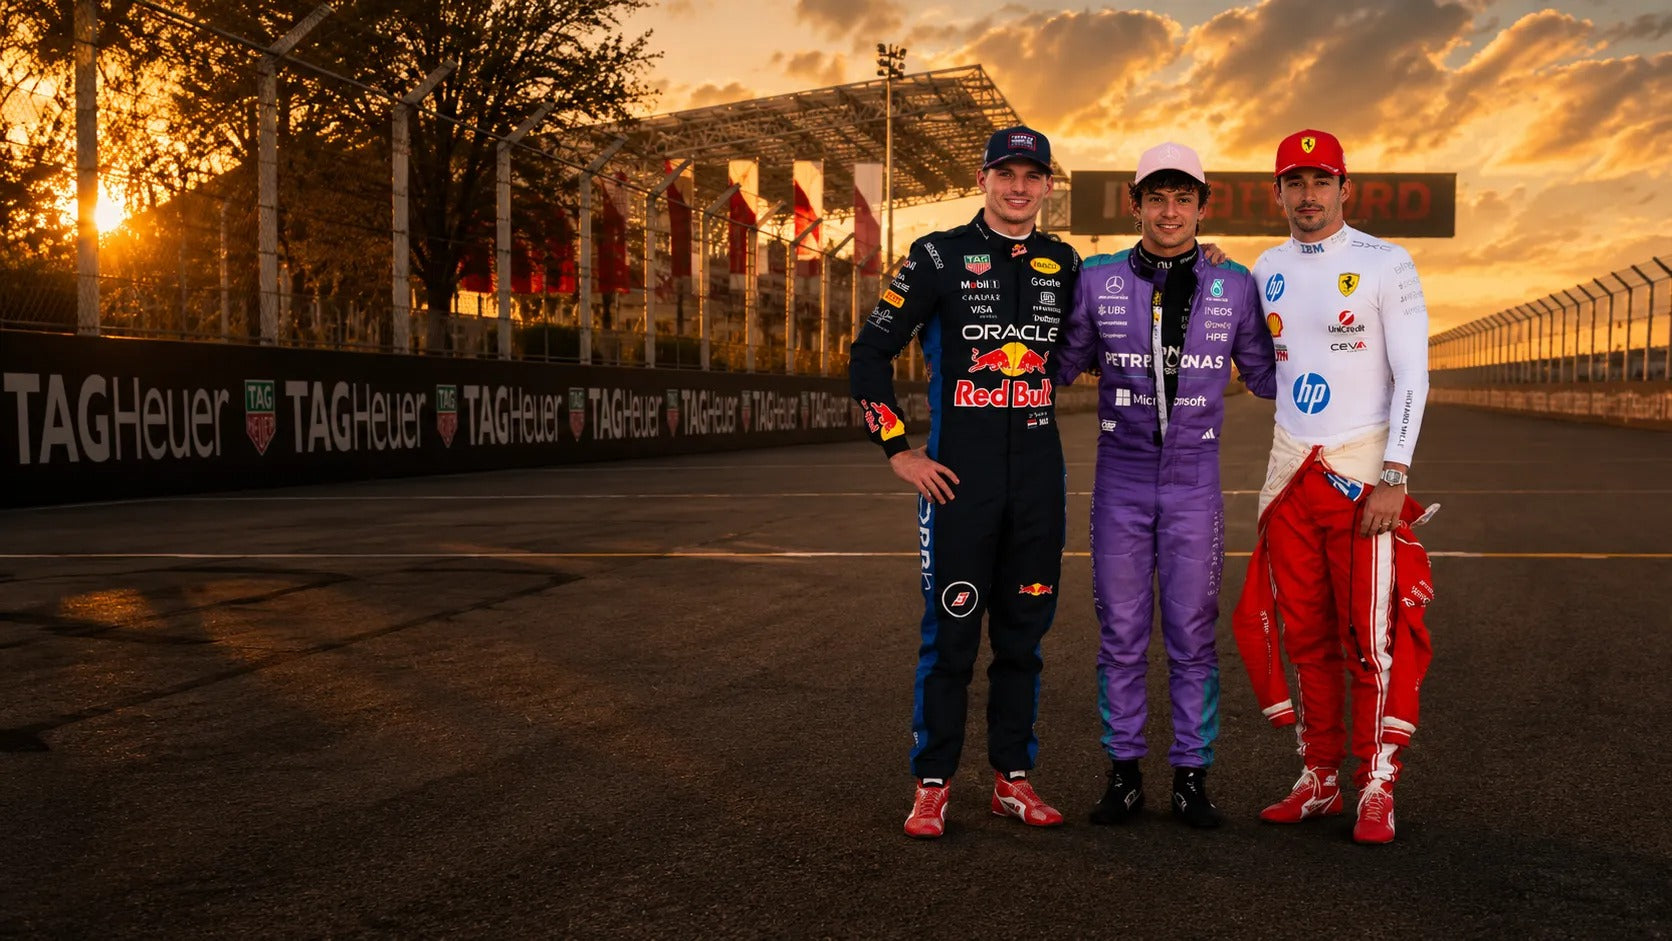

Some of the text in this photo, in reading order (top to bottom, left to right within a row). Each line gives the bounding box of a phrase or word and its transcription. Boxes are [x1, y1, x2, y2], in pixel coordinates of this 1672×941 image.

[1300, 244, 1325, 254] IBM
[960, 280, 989, 290] Mobil
[970, 305, 993, 314] VISA
[1107, 306, 1126, 315] UBS
[1204, 307, 1233, 316] INEOS
[962, 324, 1059, 343] ORACLE
[1206, 333, 1228, 342] HPE
[247, 385, 272, 409] TAG
[954, 378, 1053, 408] Red Bull
[1296, 373, 1326, 415] hp
